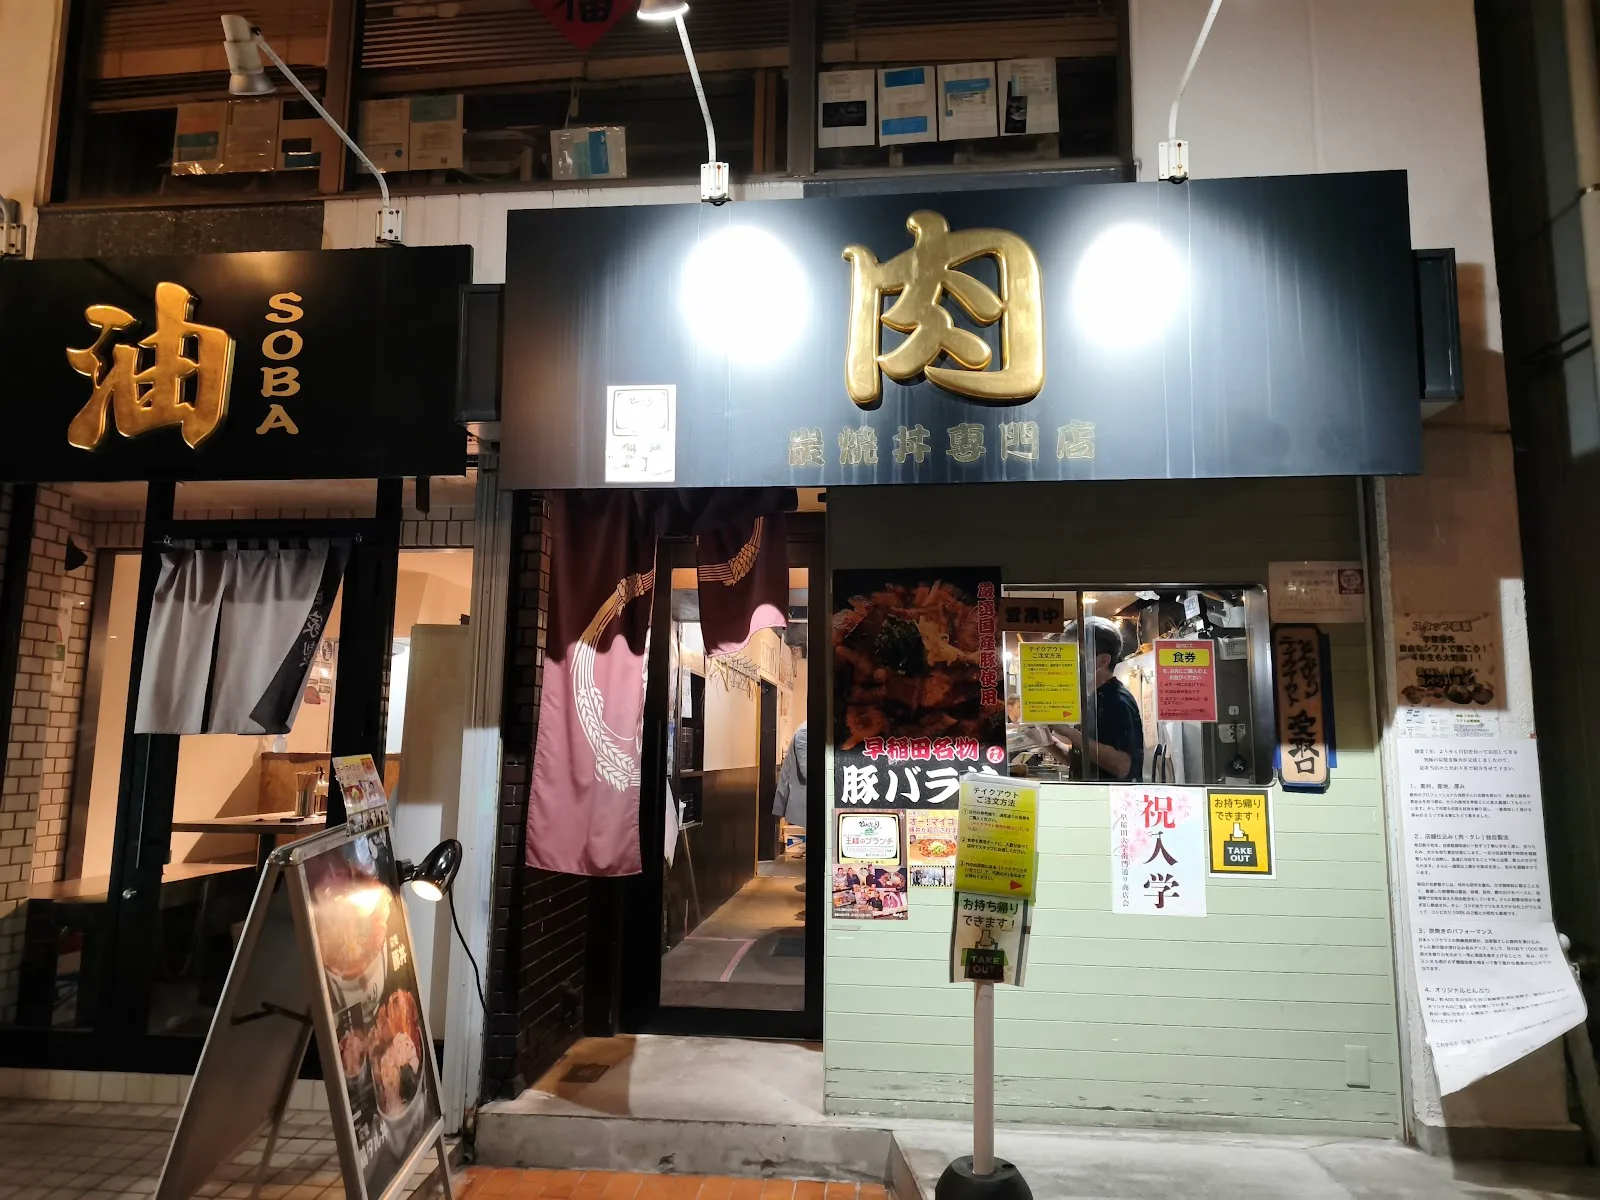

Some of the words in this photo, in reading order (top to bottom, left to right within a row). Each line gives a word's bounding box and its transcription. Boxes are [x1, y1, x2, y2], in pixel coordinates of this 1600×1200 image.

[842, 209, 1046, 408] 肉
[66, 281, 237, 450] 油
[256, 292, 304, 436] SOBA
[977, 582, 998, 706] 厳選国産豚使用
[1173, 651, 1196, 663] 食券
[863, 736, 980, 761] 早稲田名物
[1287, 710, 1320, 775] 受取口
[973, 787, 1019, 799] テイクアウト
[976, 796, 1016, 807] ご注文方法
[1214, 798, 1261, 808] お持ち帰り
[1215, 811, 1260, 821] できます!
[845, 836, 894, 845] 王様のブランチ
[1141, 794, 1180, 909] 祝入学
[1228, 846, 1253, 855] TAKE
[1230, 854, 1250, 863] OUT
[963, 899, 1019, 915] お持ち帰り
[962, 915, 1015, 929] できます!
[970, 955, 1000, 965] TAKE
[972, 965, 995, 974] OUT
